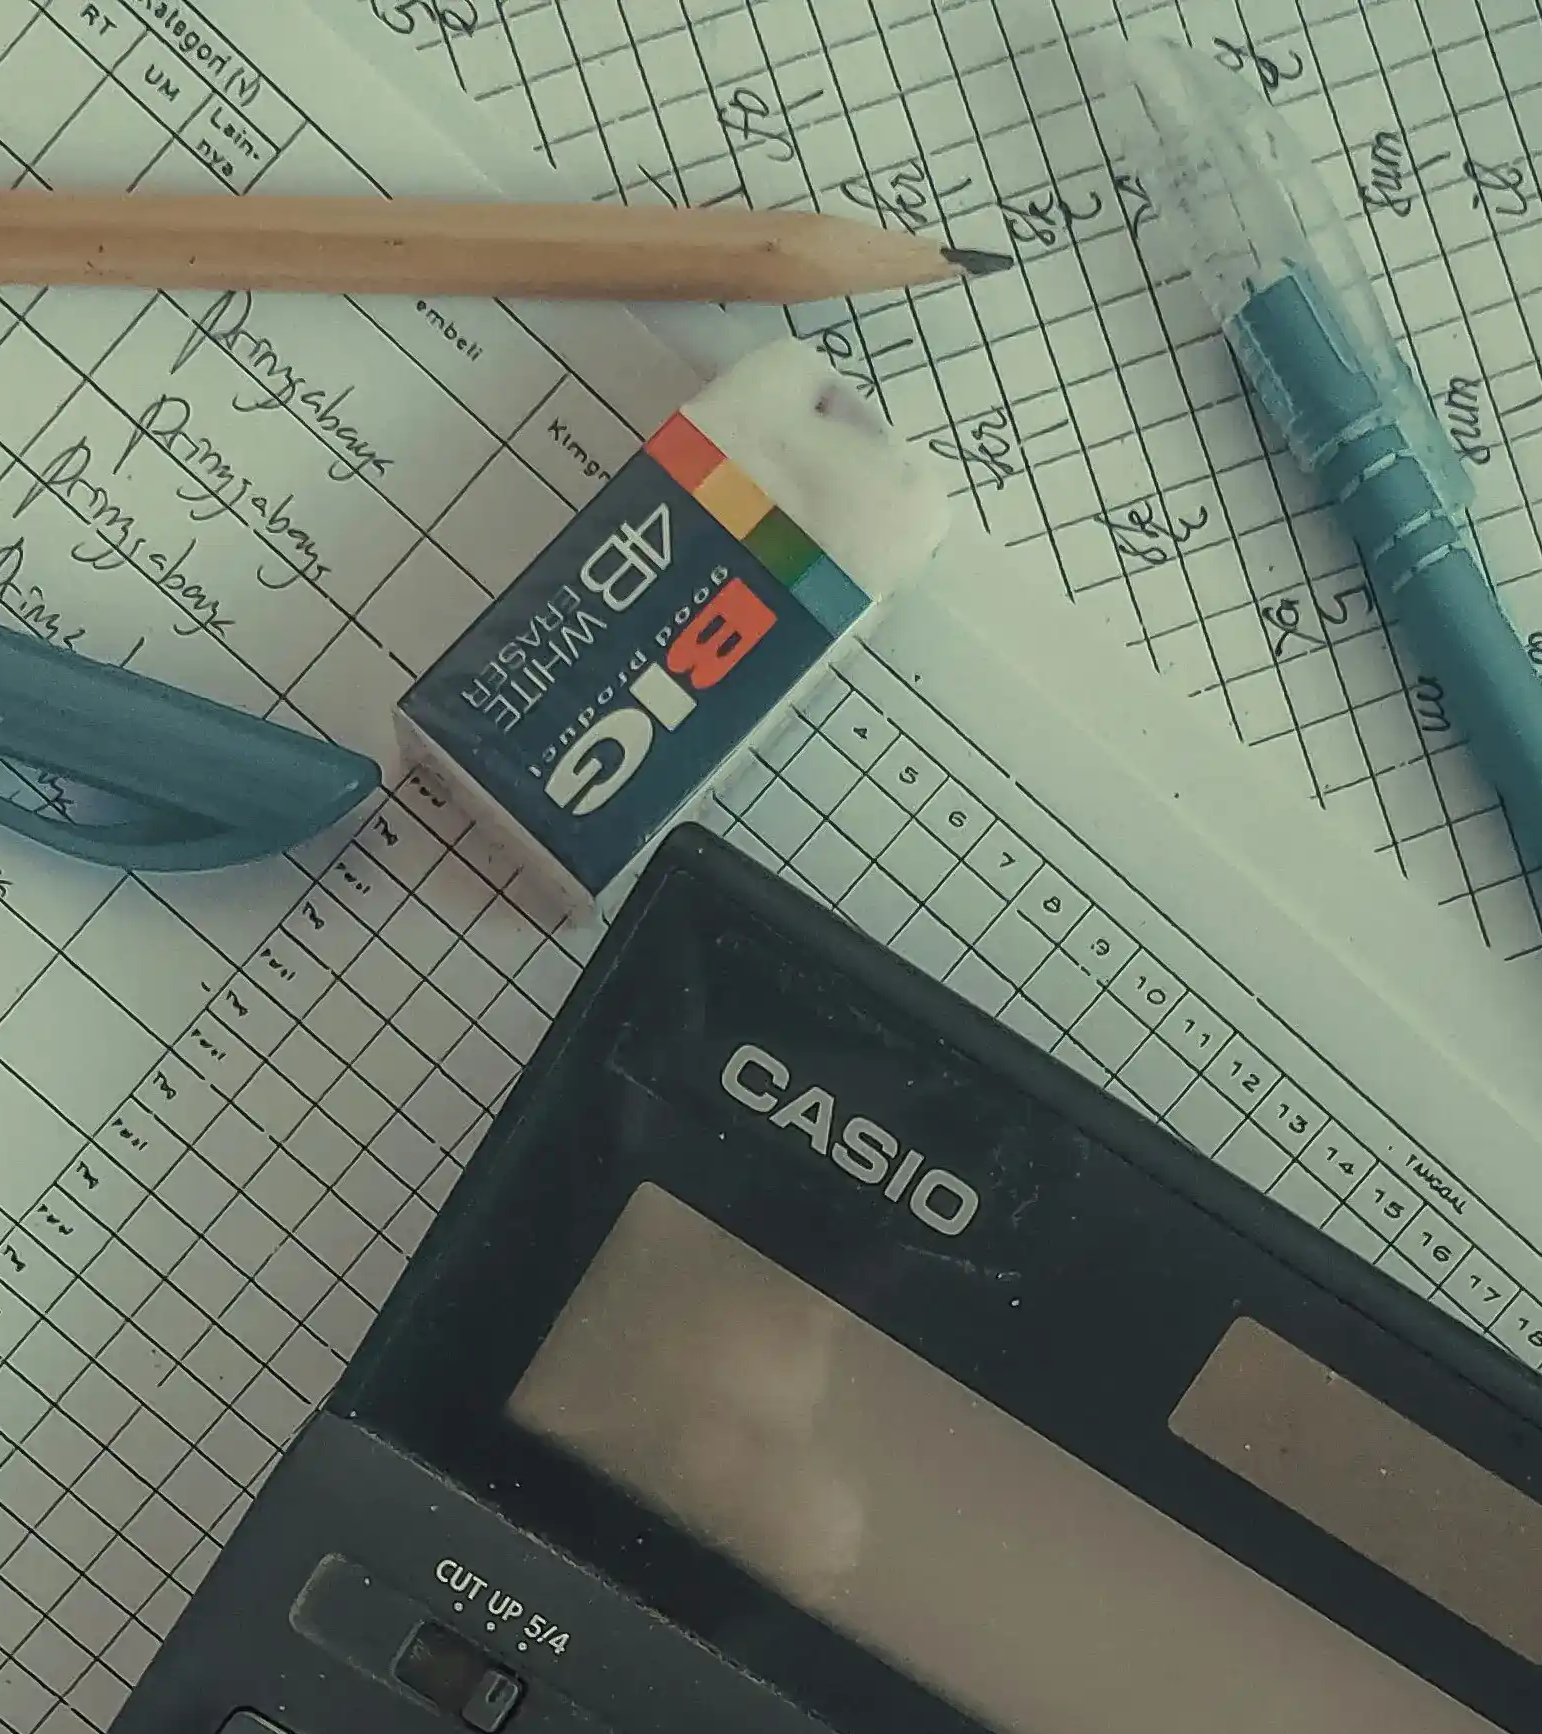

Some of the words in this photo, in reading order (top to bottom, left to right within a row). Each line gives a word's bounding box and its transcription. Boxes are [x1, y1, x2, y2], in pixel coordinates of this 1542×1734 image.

[80, 2, 118, 36] RT
[139, 0, 232, 77] ategori
[144, 63, 181, 102] UM
[416, 299, 480, 362] embeli
[579, 502, 673, 611] 4B
[657, 565, 729, 649] good
[460, 584, 579, 713] ERASER
[501, 603, 608, 733] WHITE
[528, 650, 648, 778] product
[543, 578, 778, 816] BIG
[898, 765, 919, 785] 5
[948, 810, 968, 828] 6
[999, 851, 1016, 868] 7
[1137, 975, 1167, 1005] 10
[1184, 1018, 1211, 1048] 11
[1231, 1060, 1261, 1094] 12
[1278, 1103, 1309, 1134] 13
[718, 1044, 979, 1236] CASIO
[1326, 1146, 1355, 1176] 14
[1374, 1188, 1405, 1219] 15
[1422, 1231, 1453, 1262] 16
[1470, 1274, 1502, 1302] 17
[435, 1558, 487, 1603] CUT
[485, 1587, 525, 1625] UP
[524, 1612, 572, 1656] 5/4
